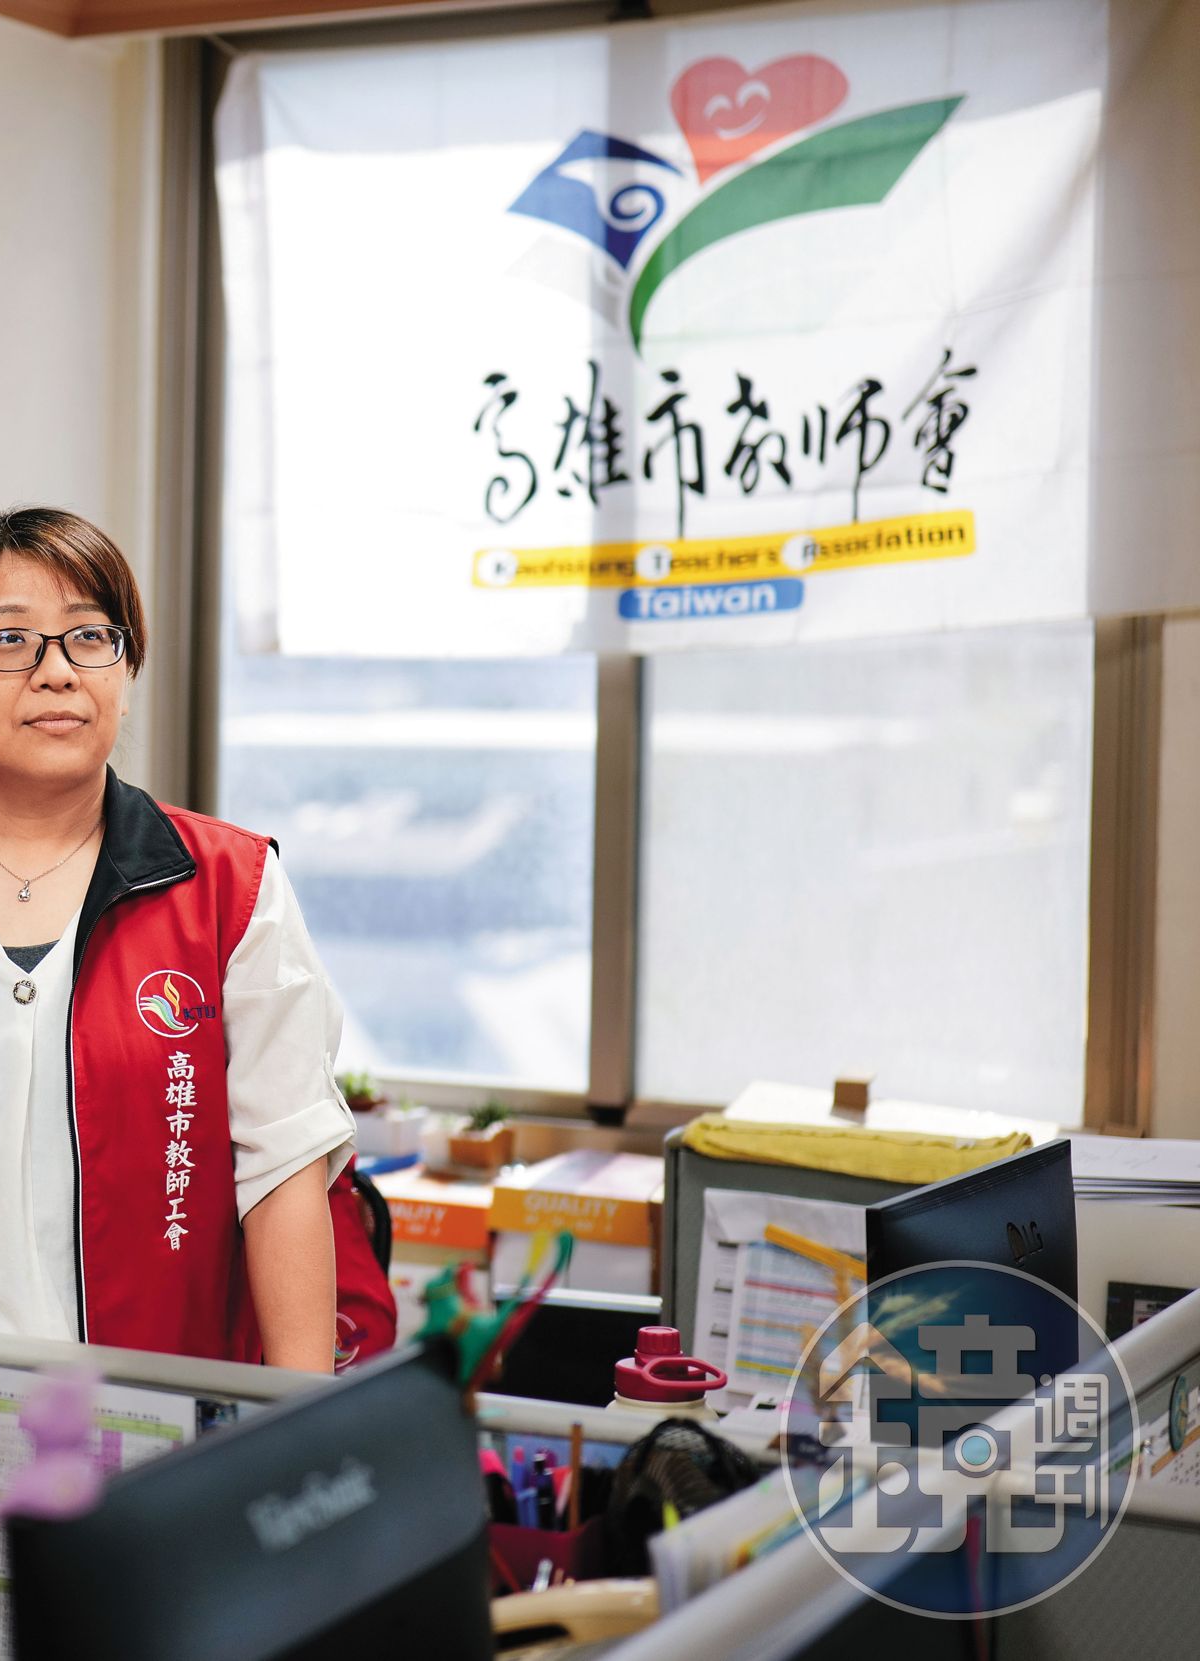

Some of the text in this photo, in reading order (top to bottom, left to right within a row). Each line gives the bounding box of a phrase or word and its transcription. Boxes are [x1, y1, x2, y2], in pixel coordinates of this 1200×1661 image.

[474, 347, 979, 538] 高雄市教師會
[637, 583, 777, 618] Taiwan
[183, 1003, 217, 1020] KTU
[162, 1049, 198, 1251] 高雄市教師工會
[523, 1191, 619, 1218] QUALITY
